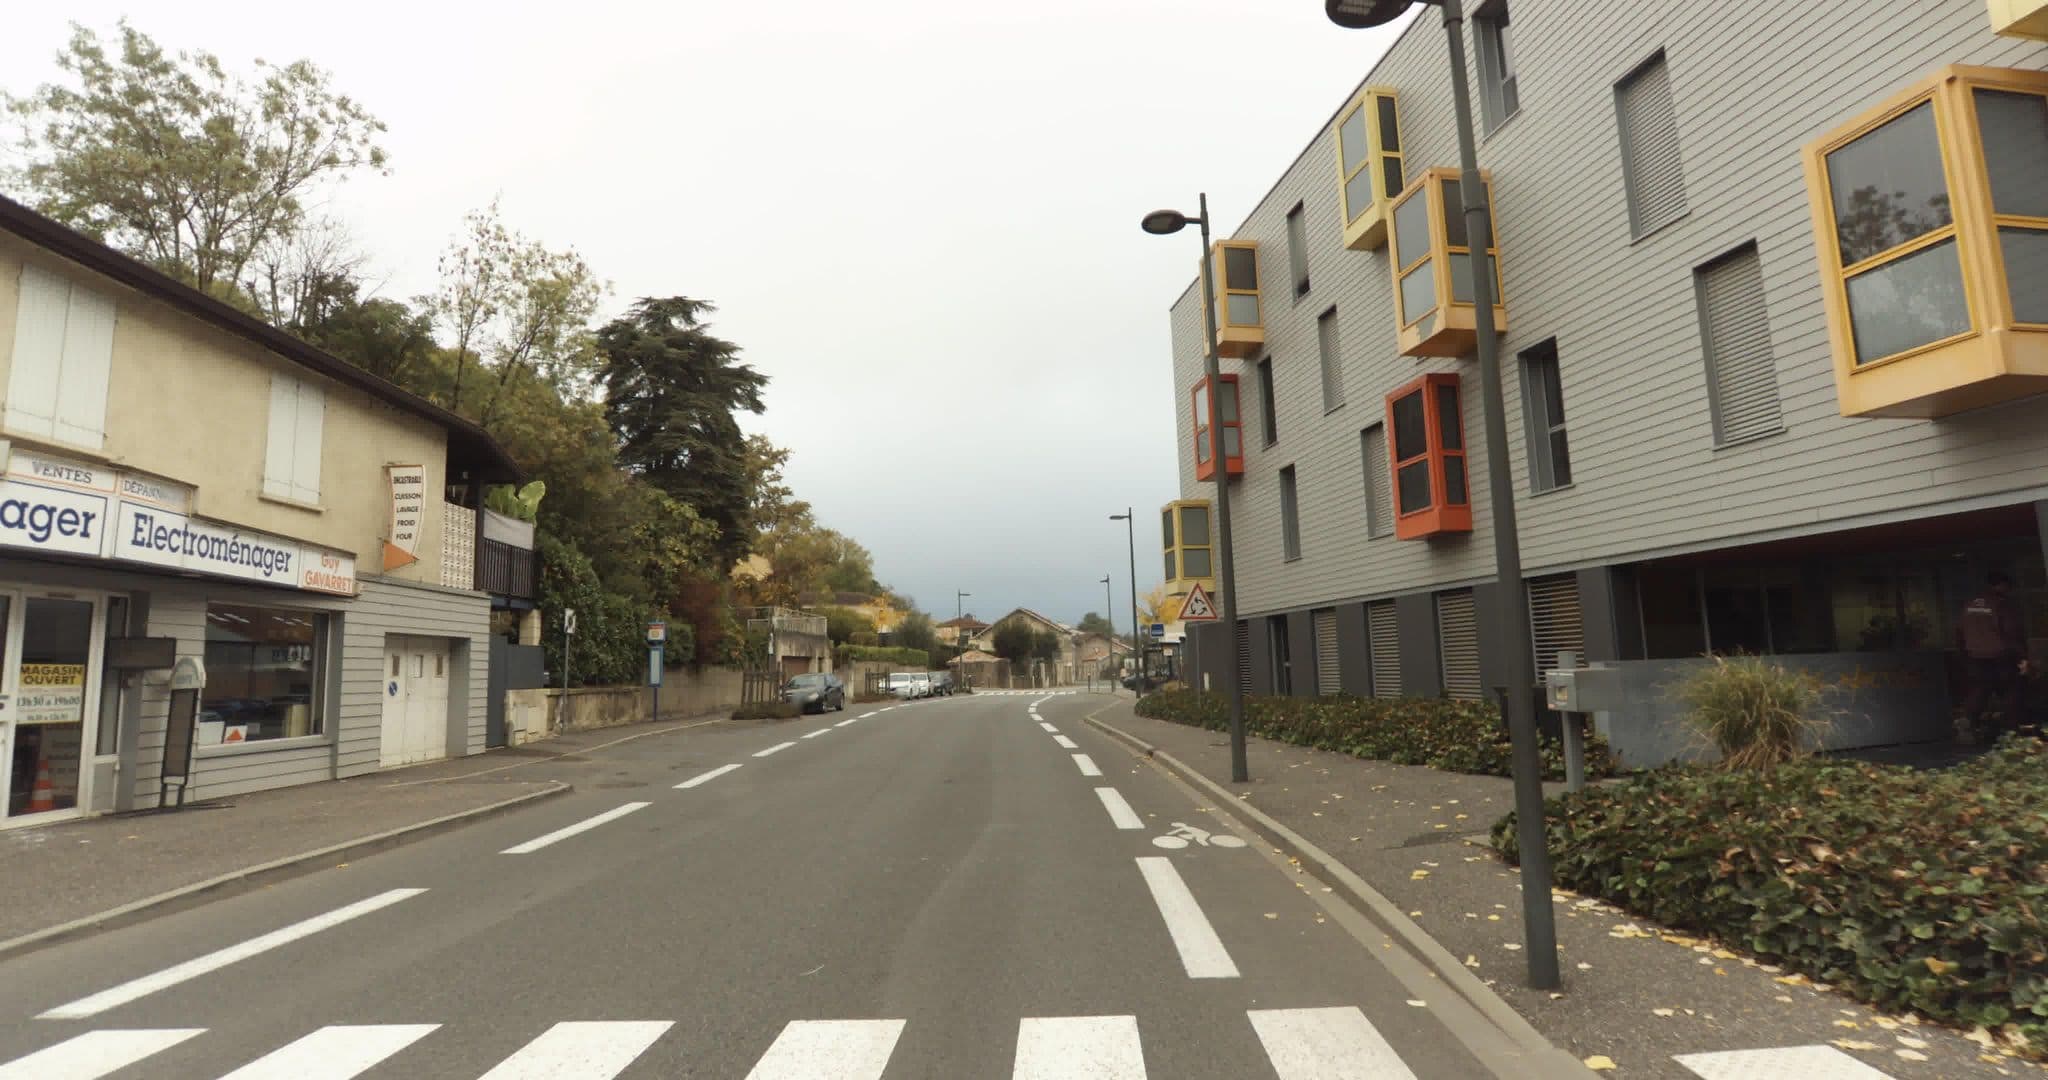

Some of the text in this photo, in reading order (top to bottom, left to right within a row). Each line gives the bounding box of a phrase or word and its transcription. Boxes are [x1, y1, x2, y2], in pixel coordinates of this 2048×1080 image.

[31, 461, 93, 484] VENTES
[394, 492, 421, 500] CUISSON
[396, 505, 419, 513] LAVAGE
[396, 519, 416, 527] FROID
[395, 532, 413, 541] FOUR
[131, 512, 292, 577] Electroménager
[320, 551, 340, 574] Guy
[304, 570, 353, 593] GAVARRET
[20, 665, 83, 675] MAGASIN
[23, 675, 76, 685] OUVERT
